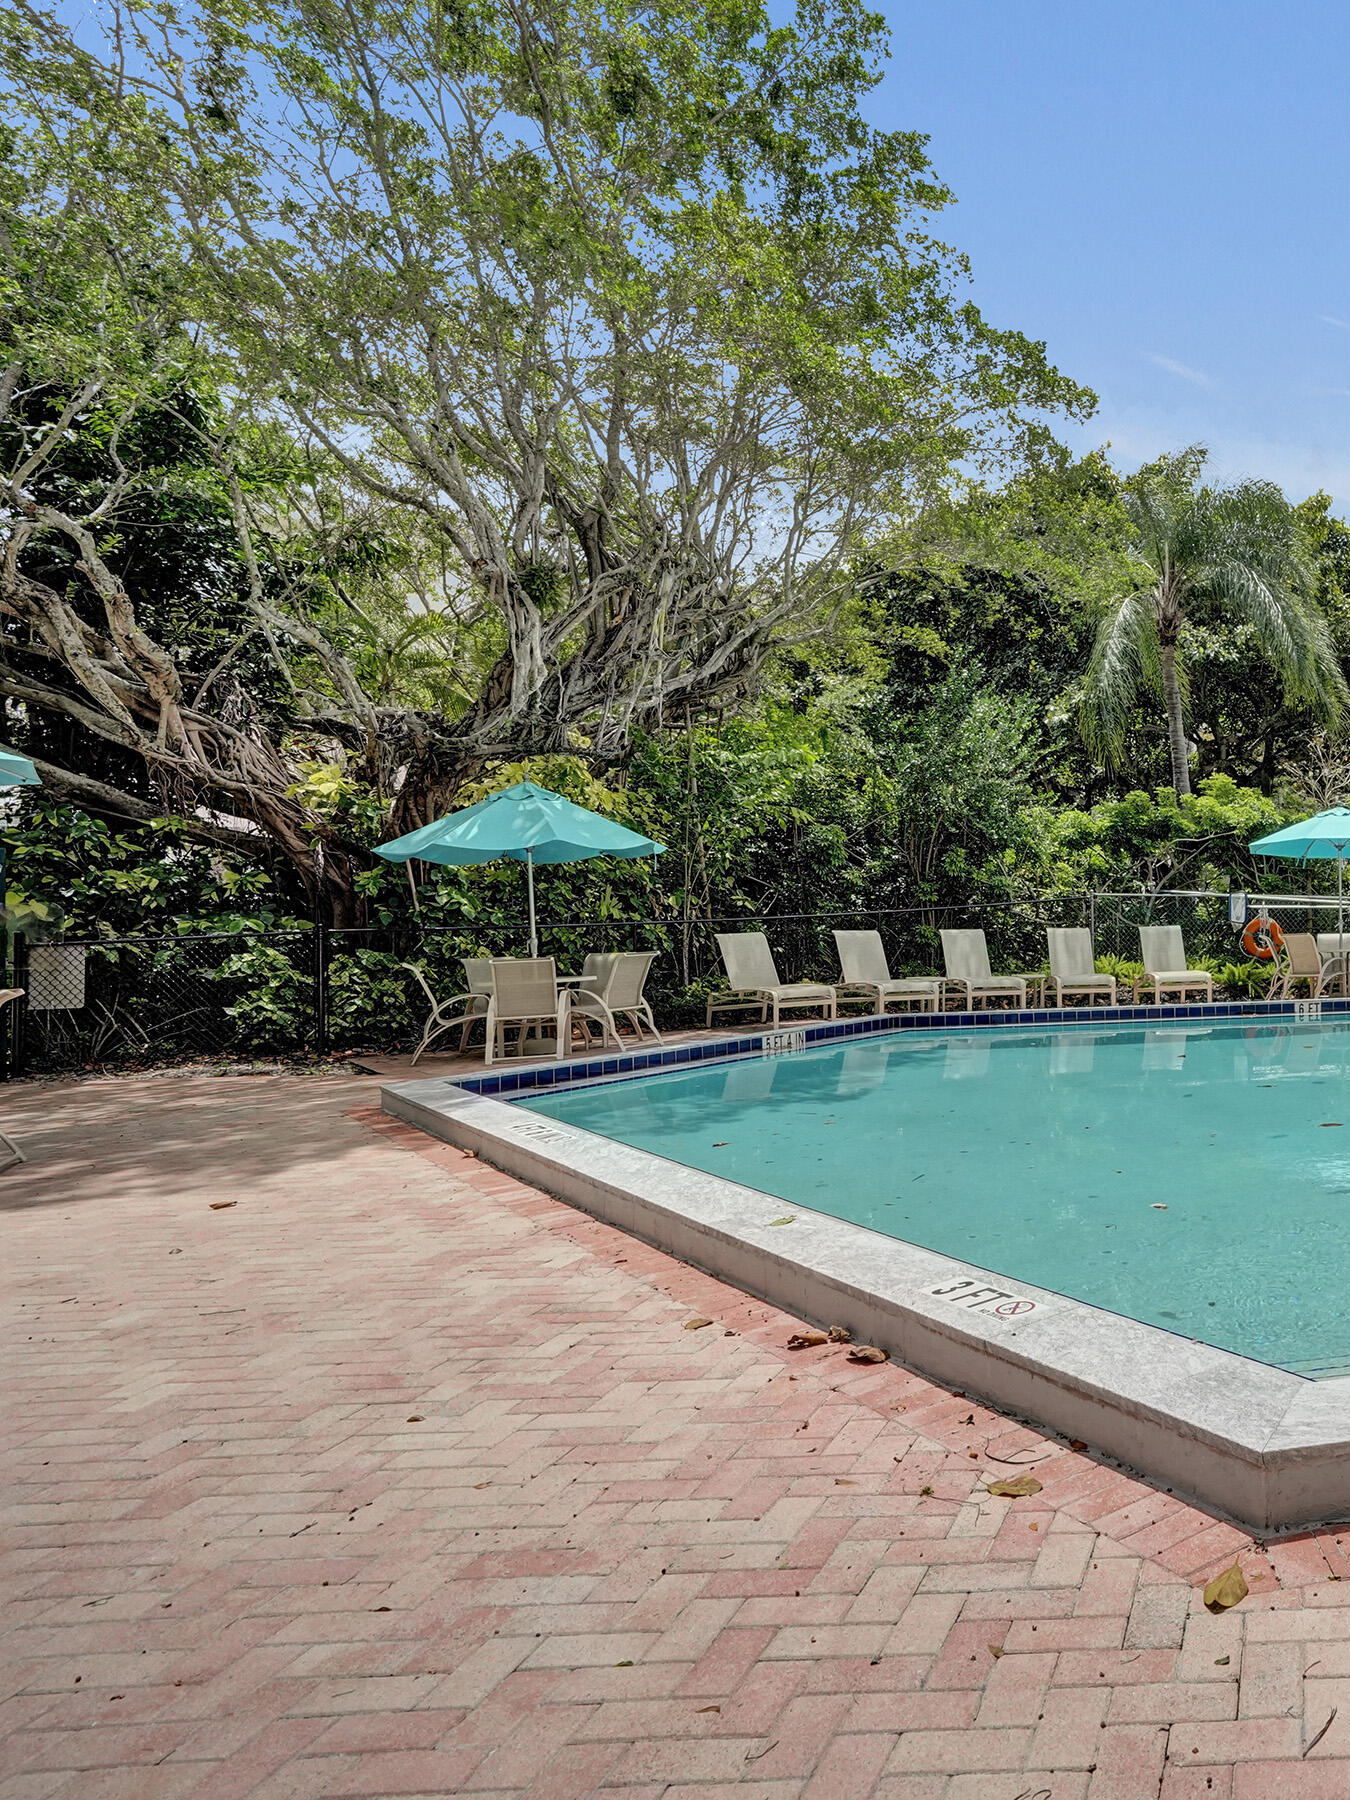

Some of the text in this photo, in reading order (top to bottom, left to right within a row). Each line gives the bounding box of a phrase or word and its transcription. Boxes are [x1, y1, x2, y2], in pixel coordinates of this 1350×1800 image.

[1299, 1003, 1320, 1013] 6 FT
[931, 1281, 1014, 1308] 3 FT
